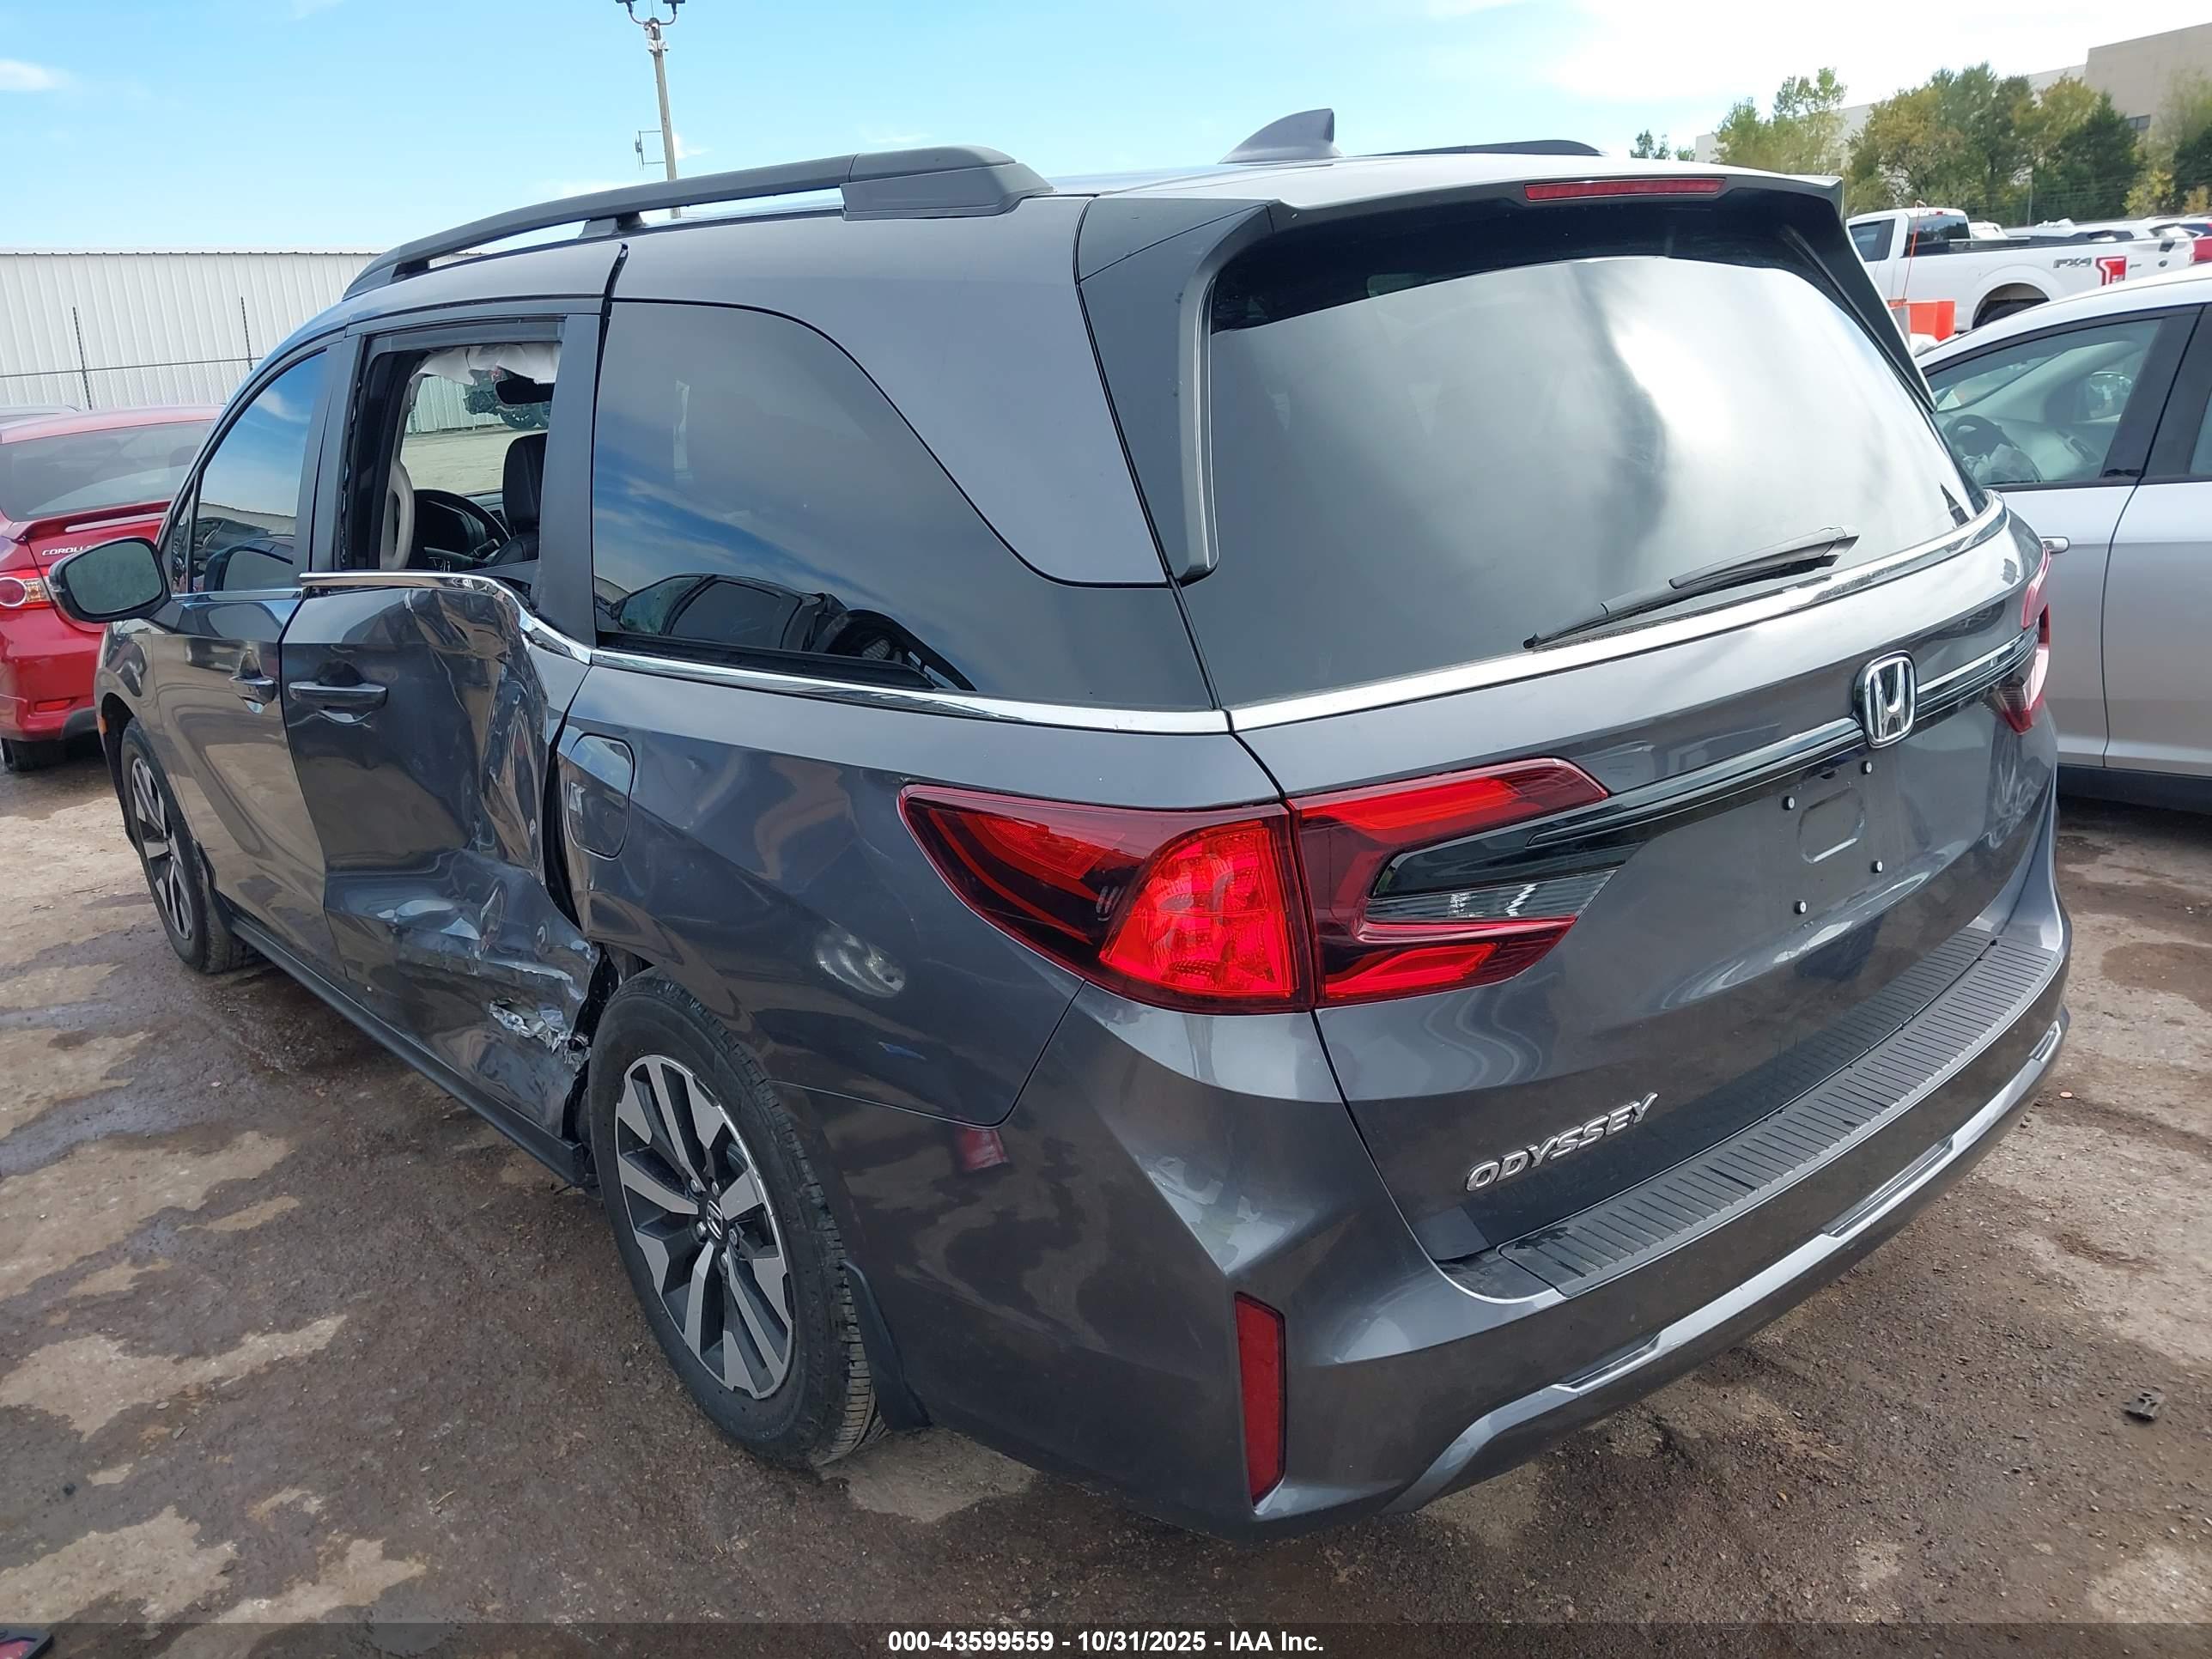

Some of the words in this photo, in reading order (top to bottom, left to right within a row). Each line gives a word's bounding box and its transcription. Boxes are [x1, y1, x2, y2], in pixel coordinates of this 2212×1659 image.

[2053, 258, 2092, 268] FX4
[42, 545, 92, 556] COROLL
[1466, 1091, 1659, 1192] ODYSSEY
